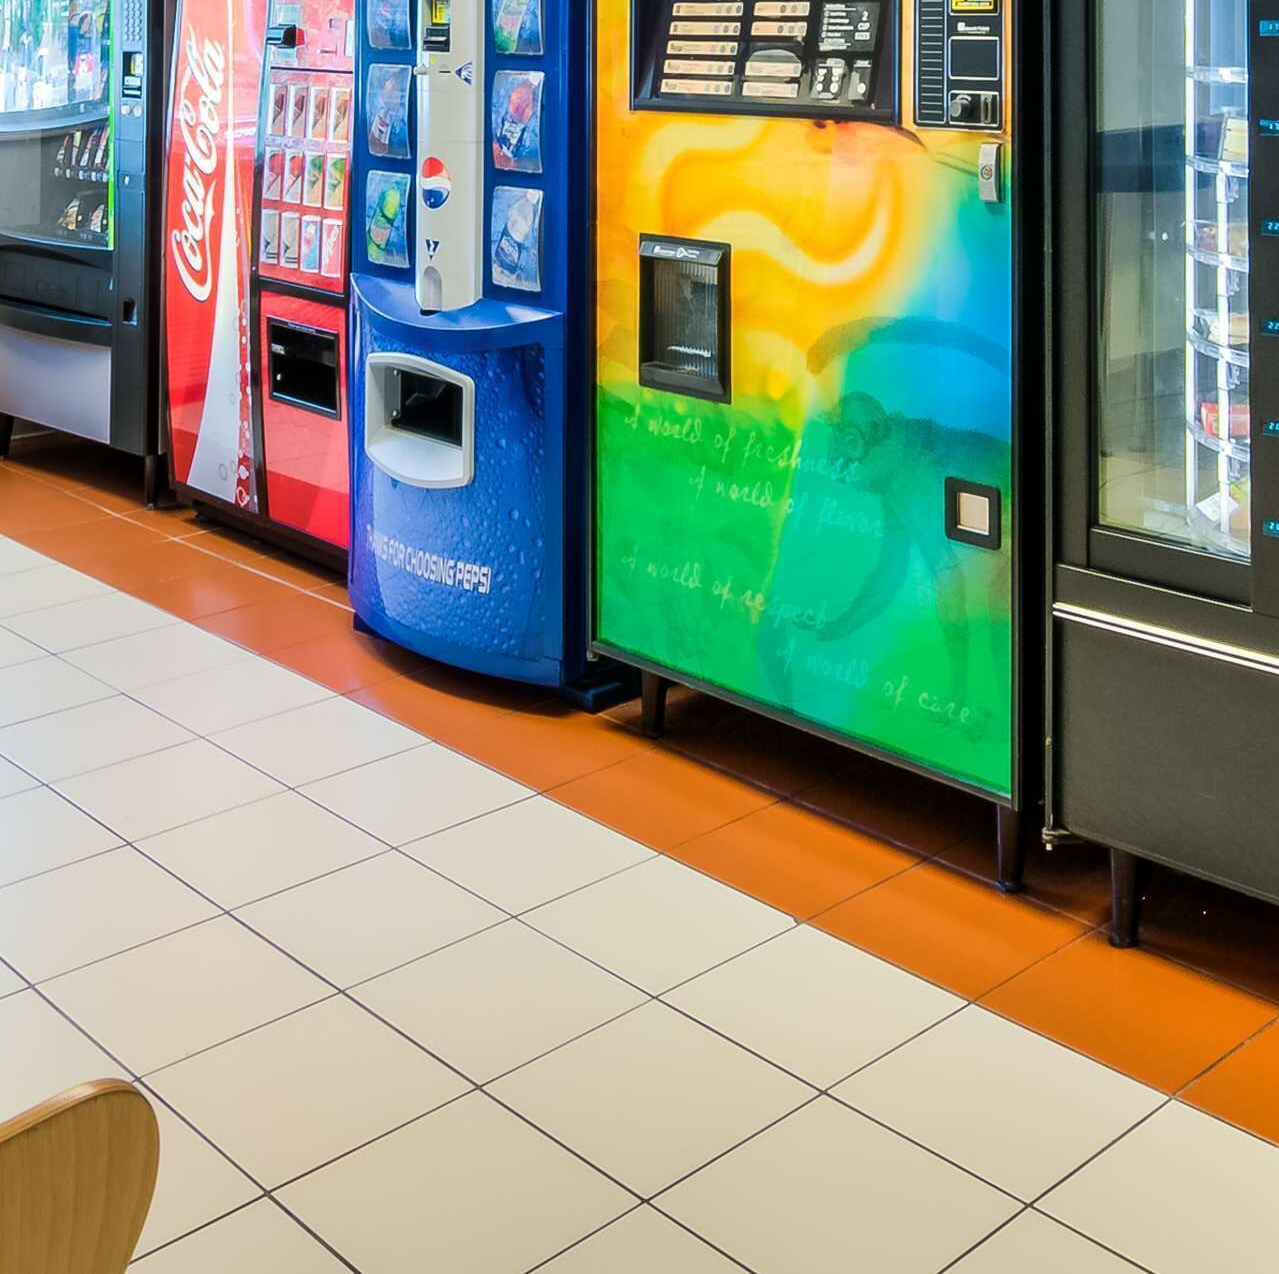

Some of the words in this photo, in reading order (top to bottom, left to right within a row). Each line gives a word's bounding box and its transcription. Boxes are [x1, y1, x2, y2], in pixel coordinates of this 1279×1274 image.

[647, 417, 702, 444] world
[714, 428, 736, 463] of
[405, 546, 456, 587] CHOOSING
[455, 560, 491, 595] PEPSI
